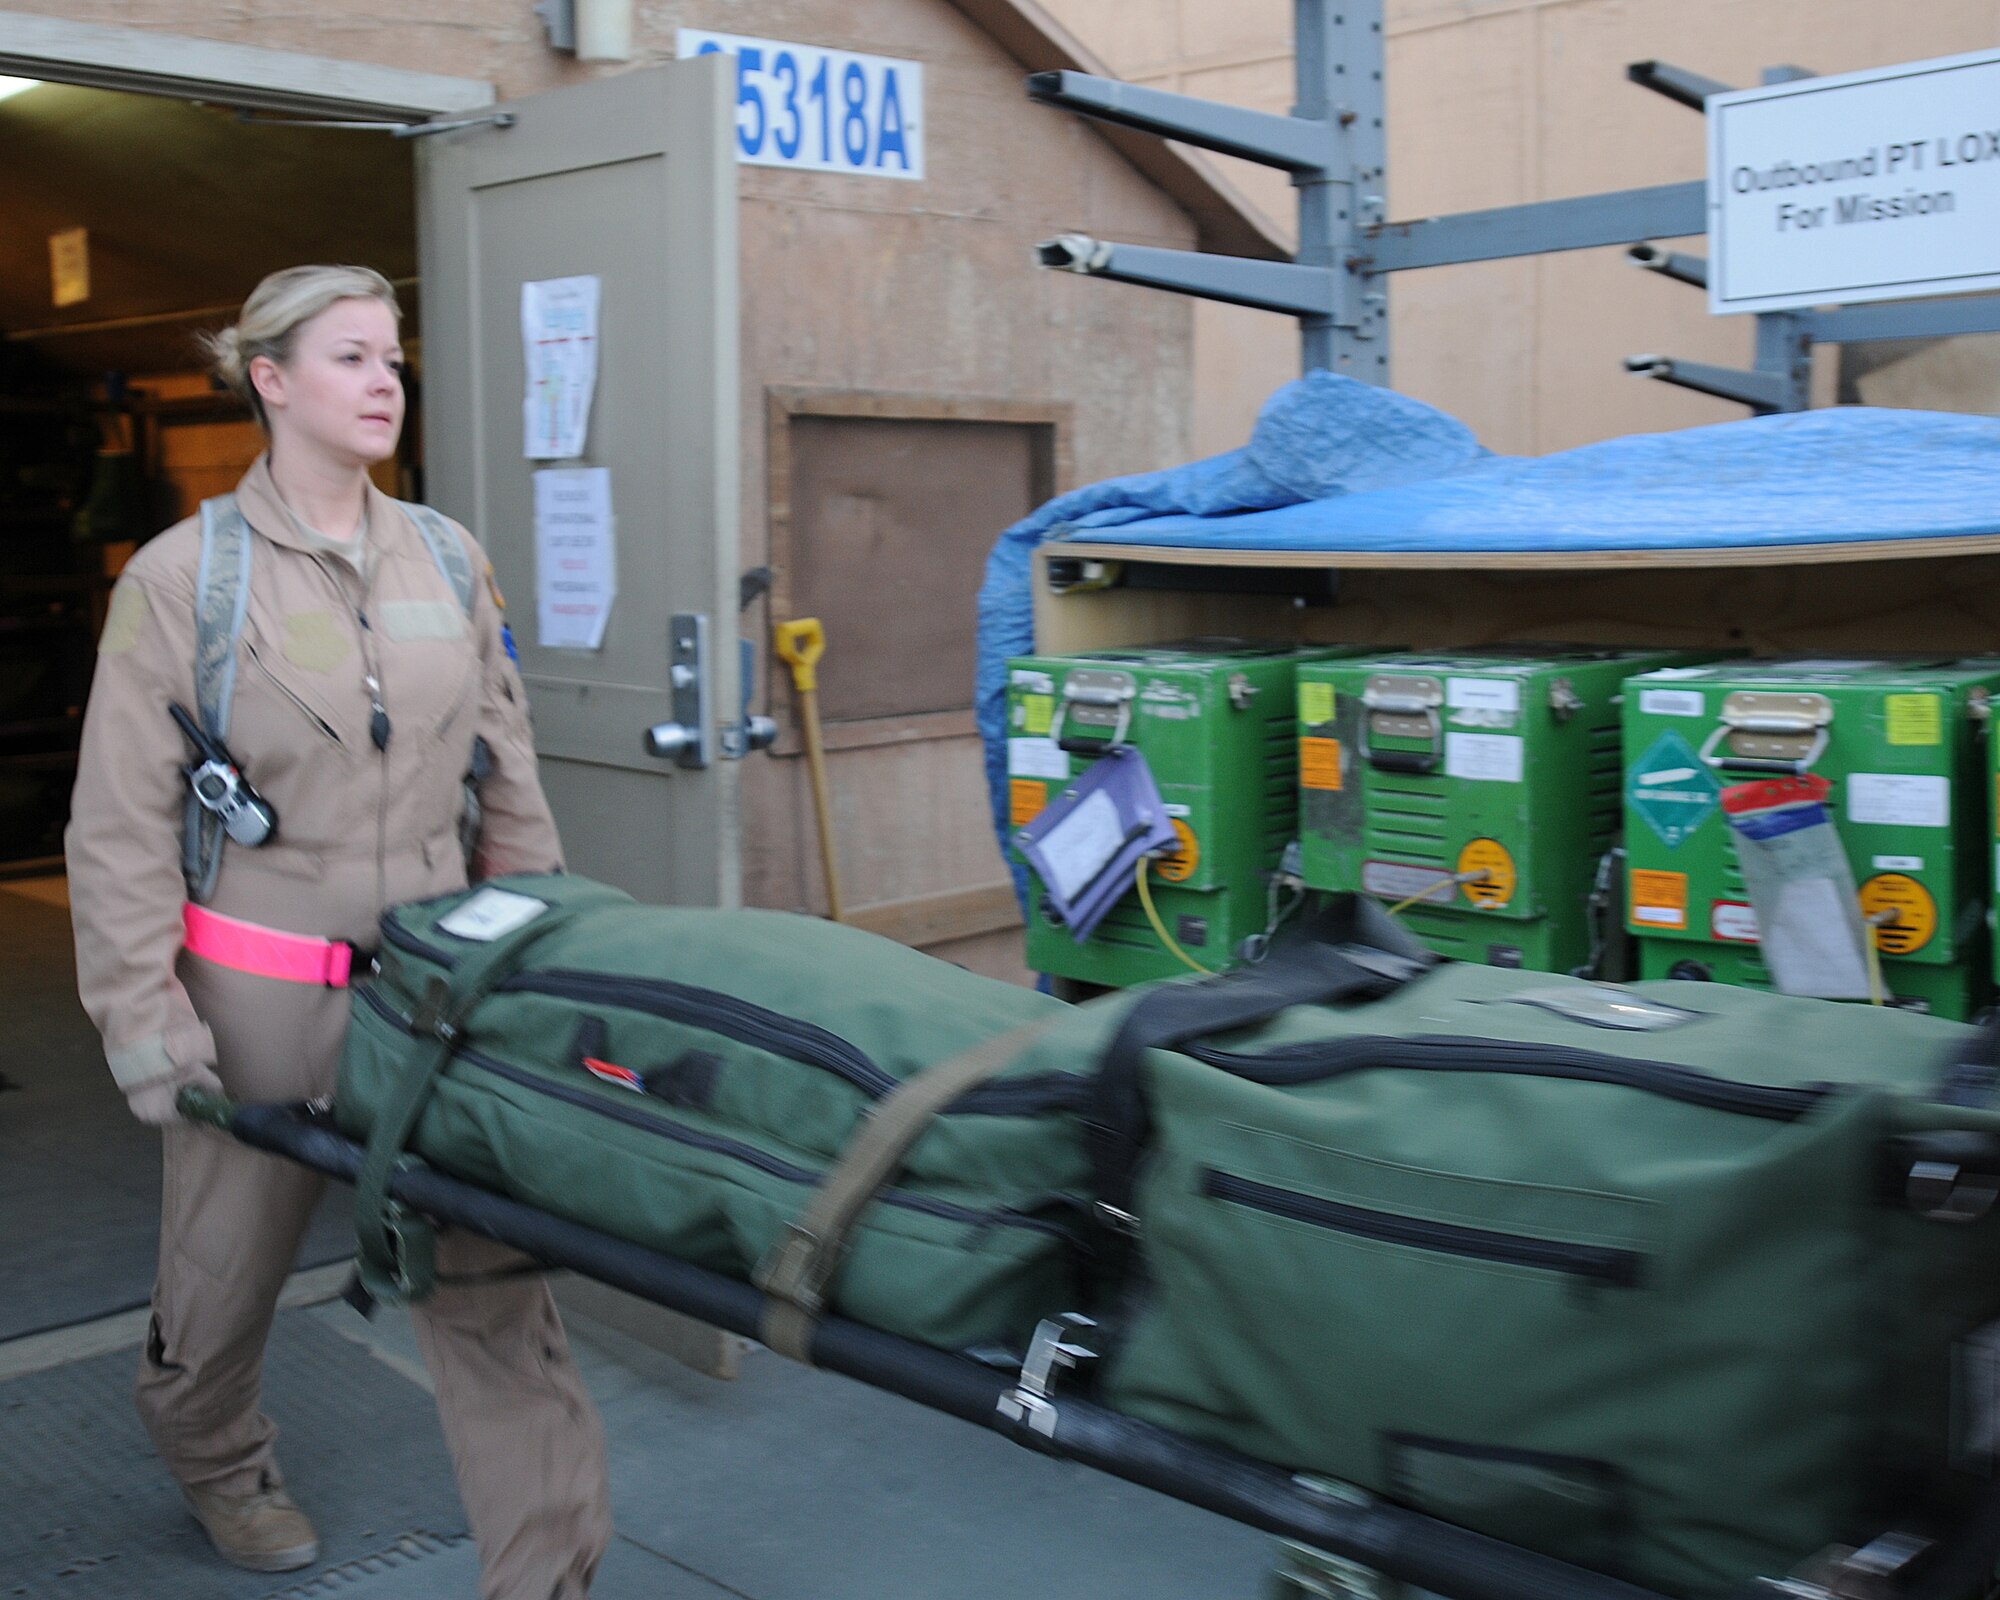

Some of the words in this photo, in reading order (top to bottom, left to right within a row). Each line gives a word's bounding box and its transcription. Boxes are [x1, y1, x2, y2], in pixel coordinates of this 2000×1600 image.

[697, 41, 910, 170] 5318A
[1732, 147, 1878, 193] Outbound
[1887, 139, 1928, 173] PT
[1776, 202, 1826, 232] For
[1834, 187, 1956, 226] Mission
